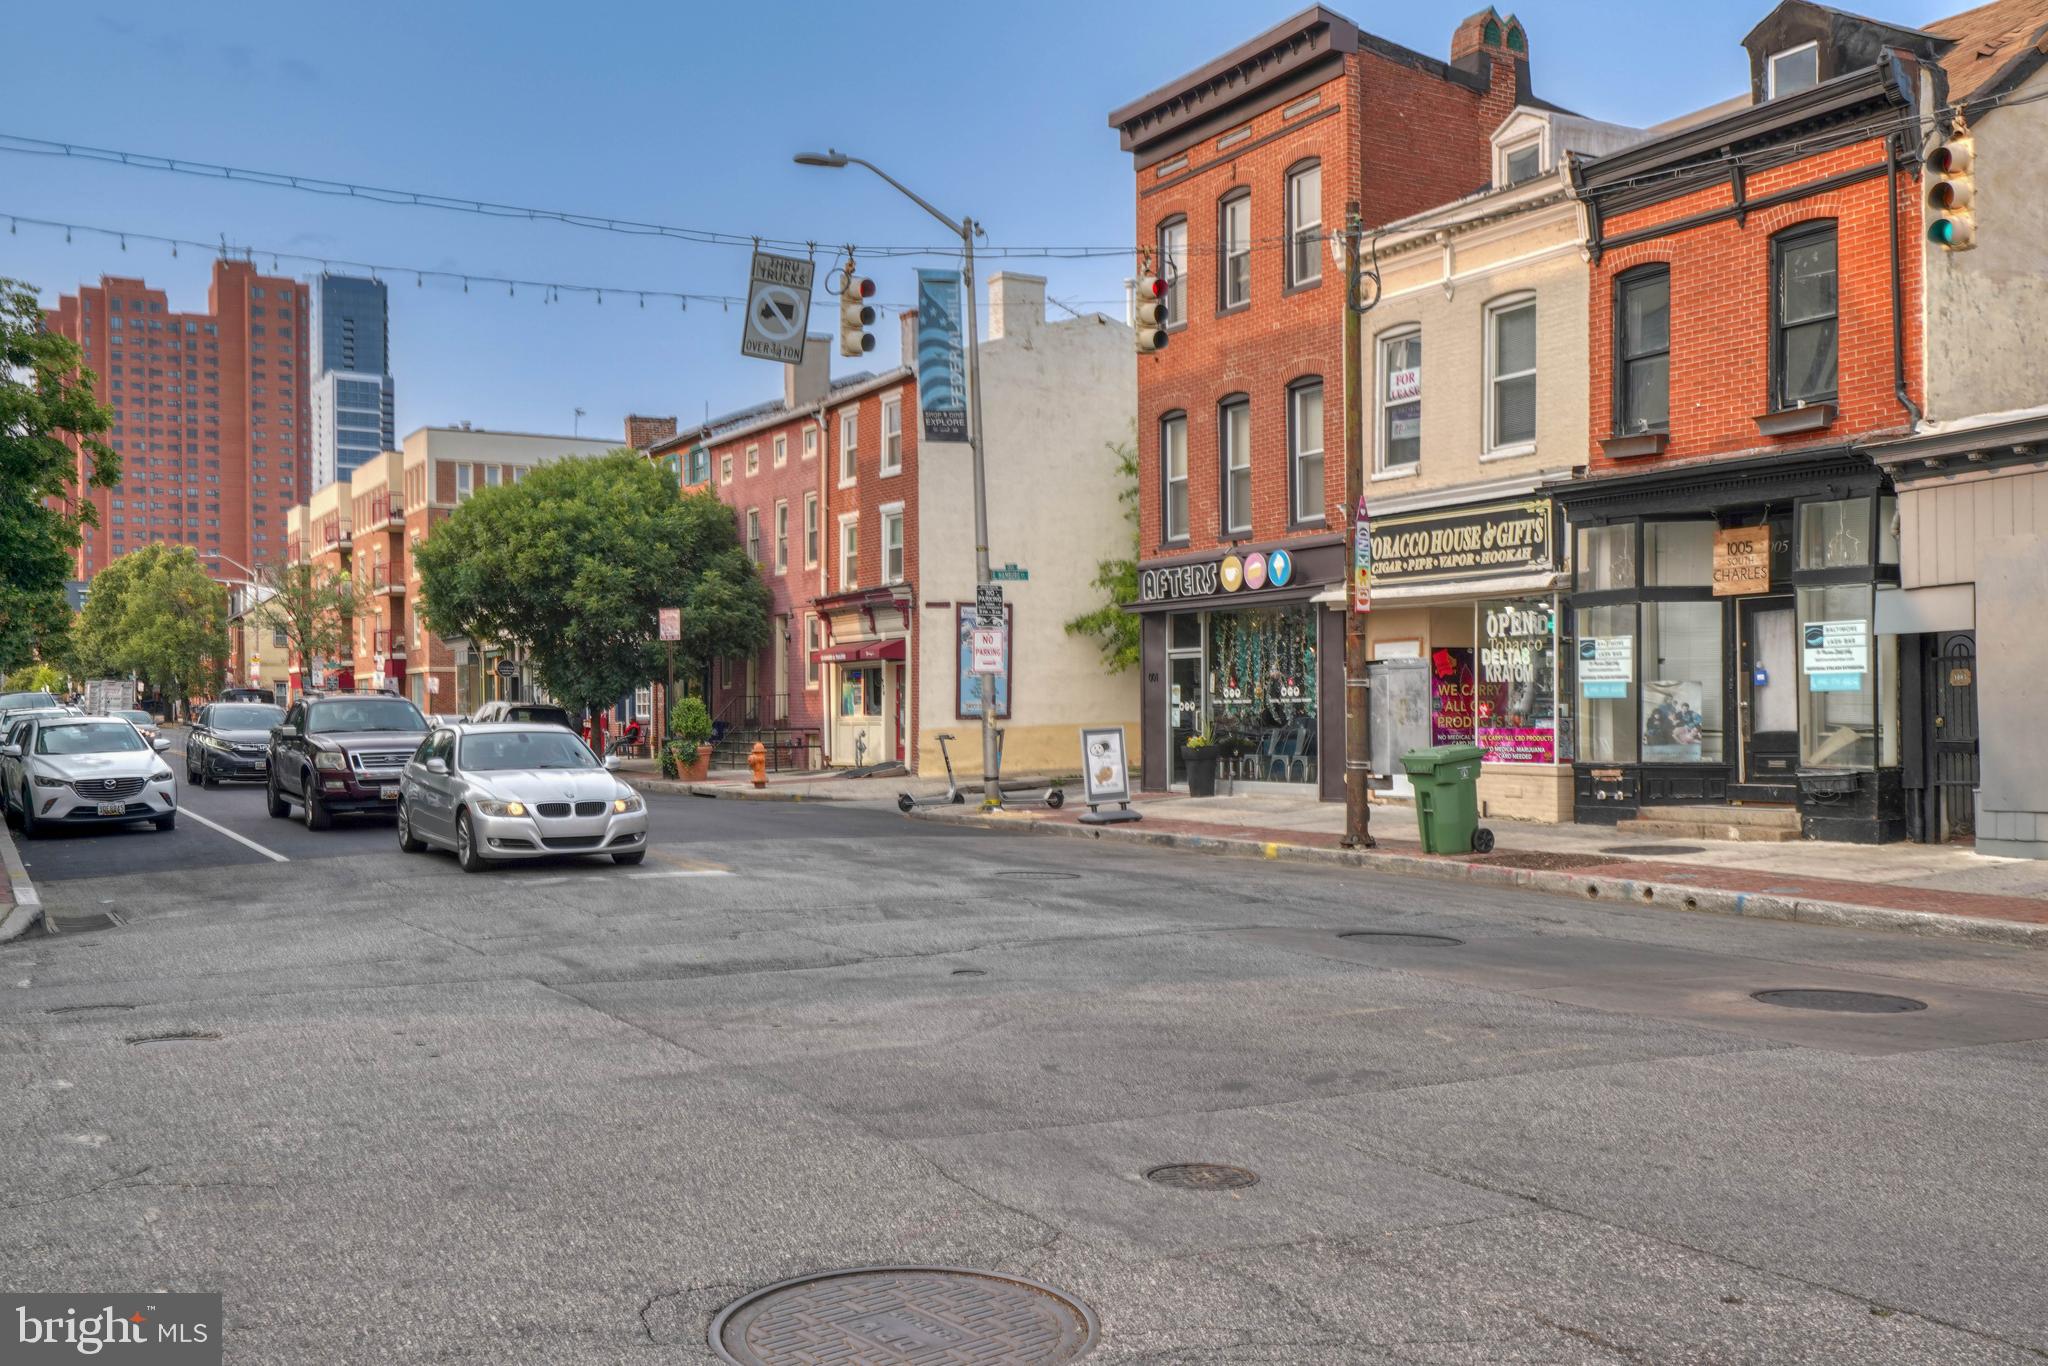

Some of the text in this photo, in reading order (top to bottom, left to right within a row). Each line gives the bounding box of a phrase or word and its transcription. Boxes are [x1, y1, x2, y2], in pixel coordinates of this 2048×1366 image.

[770, 258, 800, 272] THRU
[760, 267, 806, 286] TRUCKS
[745, 339, 769, 353] OVER
[783, 345, 800, 359] TON
[948, 330, 965, 407] FEDERAL
[1396, 371, 1416, 387] FOR
[925, 418, 965, 427] EXPLORE
[1371, 517, 1545, 560] OBACCO HOUSE & GIFTS
[1359, 527, 1370, 567] KIND
[1727, 540, 1754, 556] 1005
[1371, 547, 1533, 575] CIGAR PIPE VAPOR HOOKAH
[1727, 556, 1755, 567] SOUTH
[1142, 562, 1217, 601] AFTERS
[1713, 566, 1768, 582] CHARLES
[978, 595, 1002, 603] PARKING
[1486, 611, 1534, 638] OPEN
[982, 635, 994, 644] NO
[1487, 637, 1543, 652] Tobacco
[975, 648, 1001, 657] PARKING
[1485, 662, 1534, 683] KRATOM
[1438, 684, 1458, 697] WE
[1445, 700, 1467, 712] ALL
